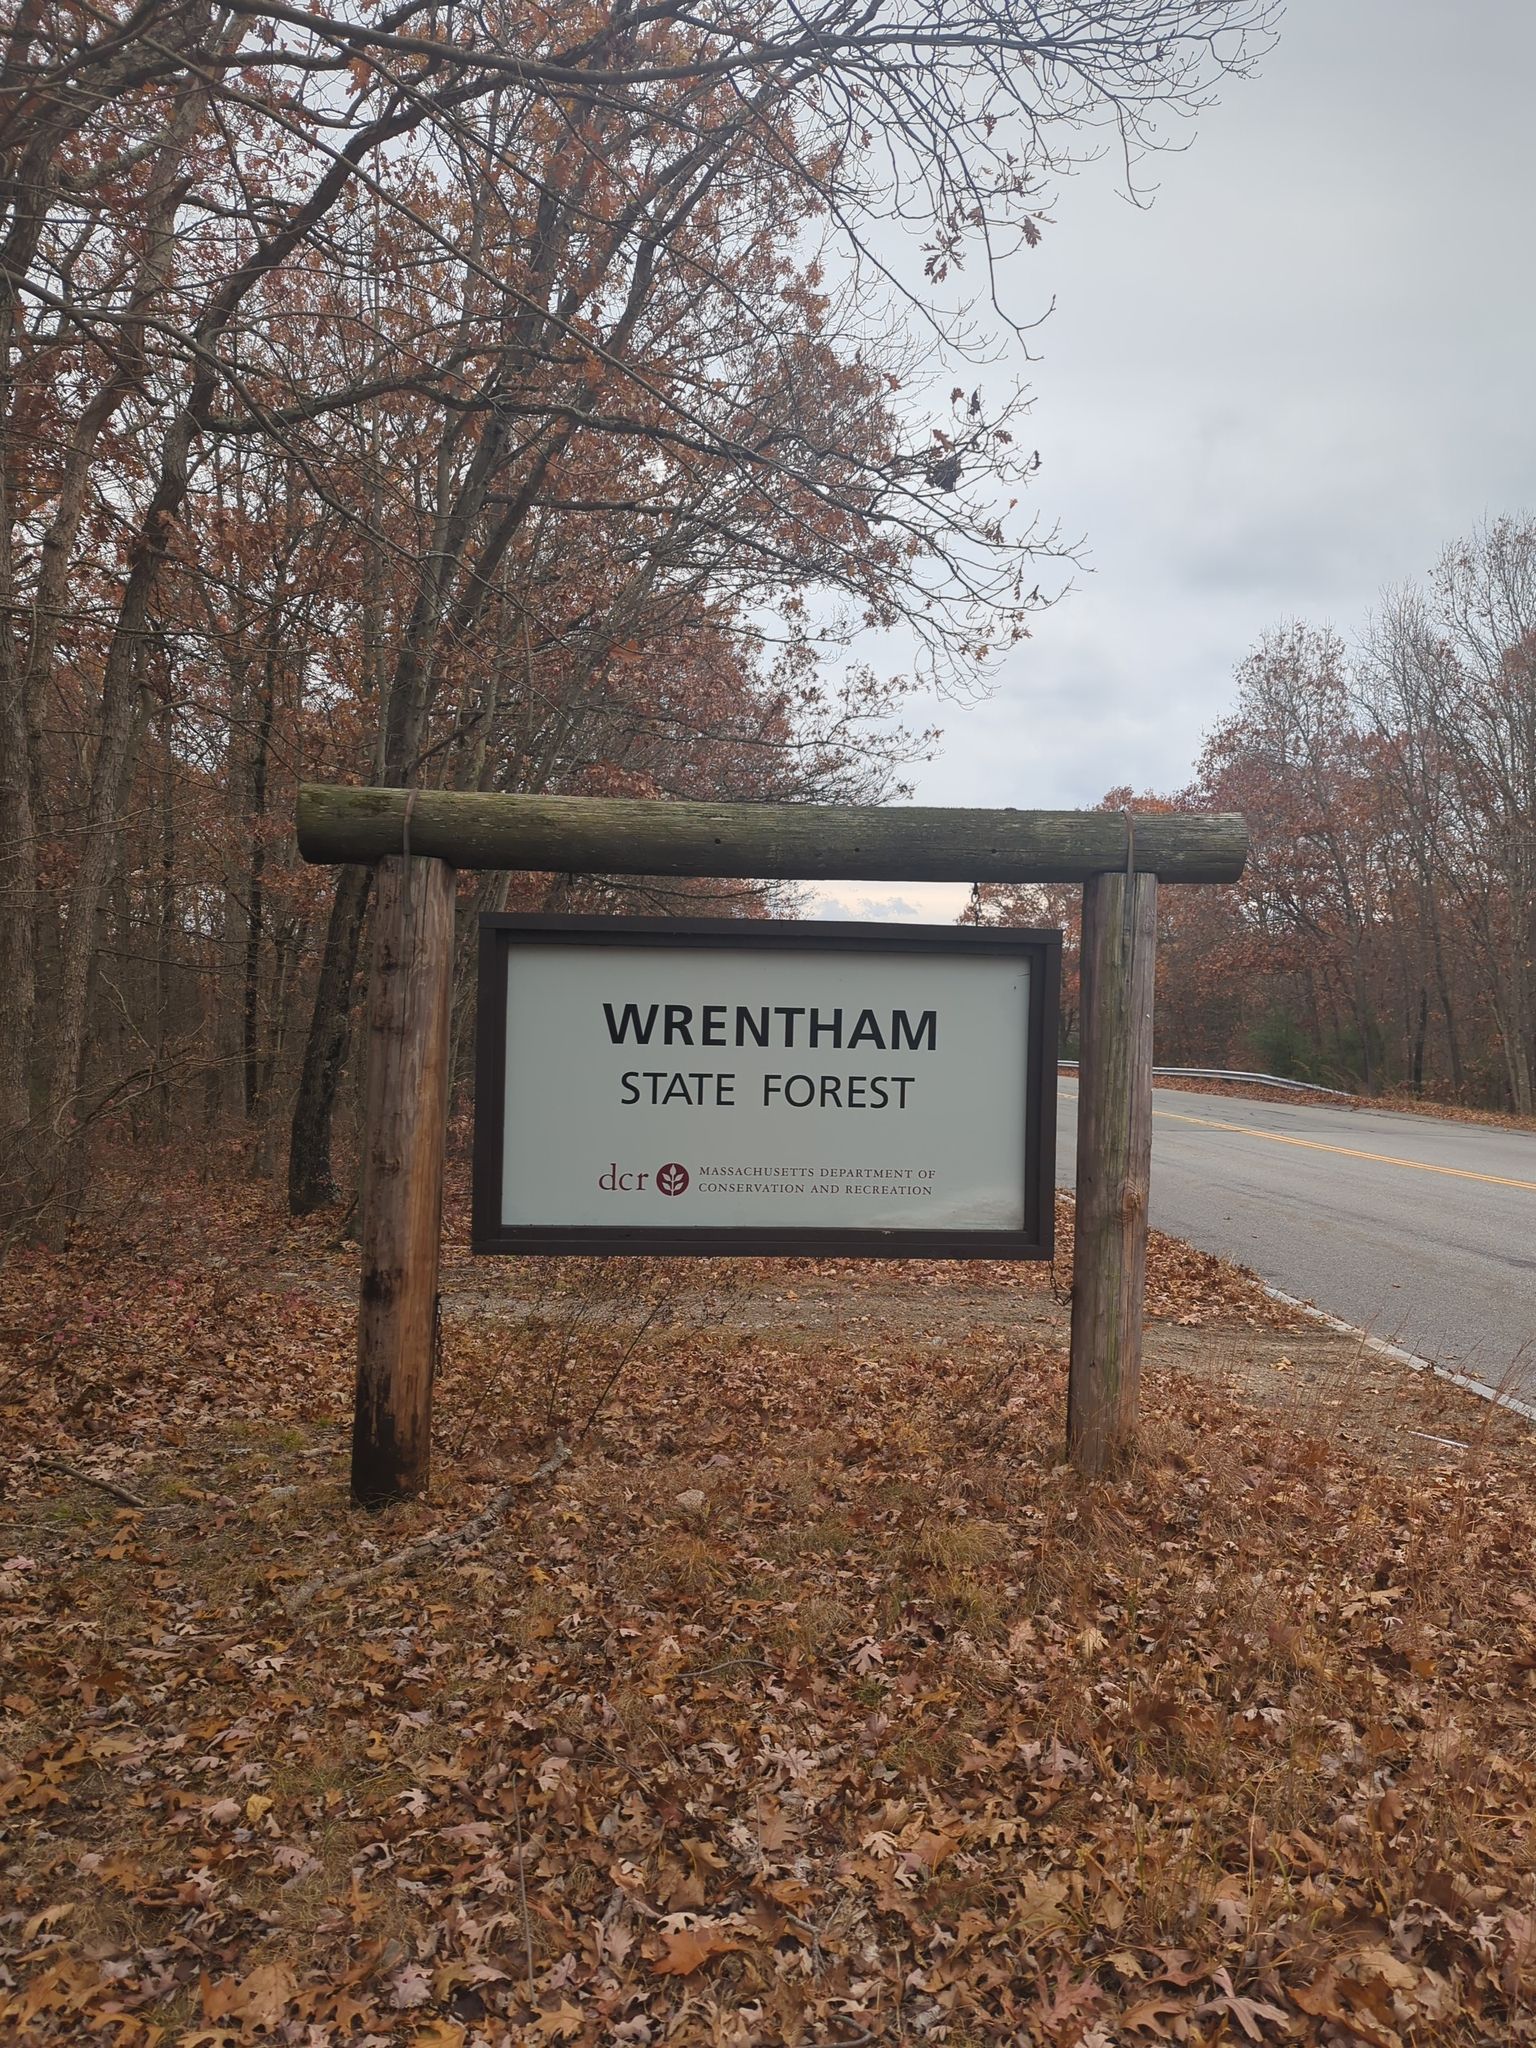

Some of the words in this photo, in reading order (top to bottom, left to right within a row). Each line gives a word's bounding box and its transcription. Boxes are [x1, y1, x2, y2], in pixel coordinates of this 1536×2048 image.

[602, 1002, 938, 1051] WRENTHAM
[620, 1071, 736, 1106] STATE
[763, 1074, 916, 1109] FOREST
[598, 1162, 649, 1191] dcr
[699, 1166, 815, 1177] MASSACHUSETTS
[820, 1168, 913, 1179] DEPARTMENT
[918, 1169, 936, 1179] OF
[698, 1183, 805, 1194] CONSERVATION
[810, 1184, 840, 1194] AND
[845, 1185, 933, 1195] RECREATION
